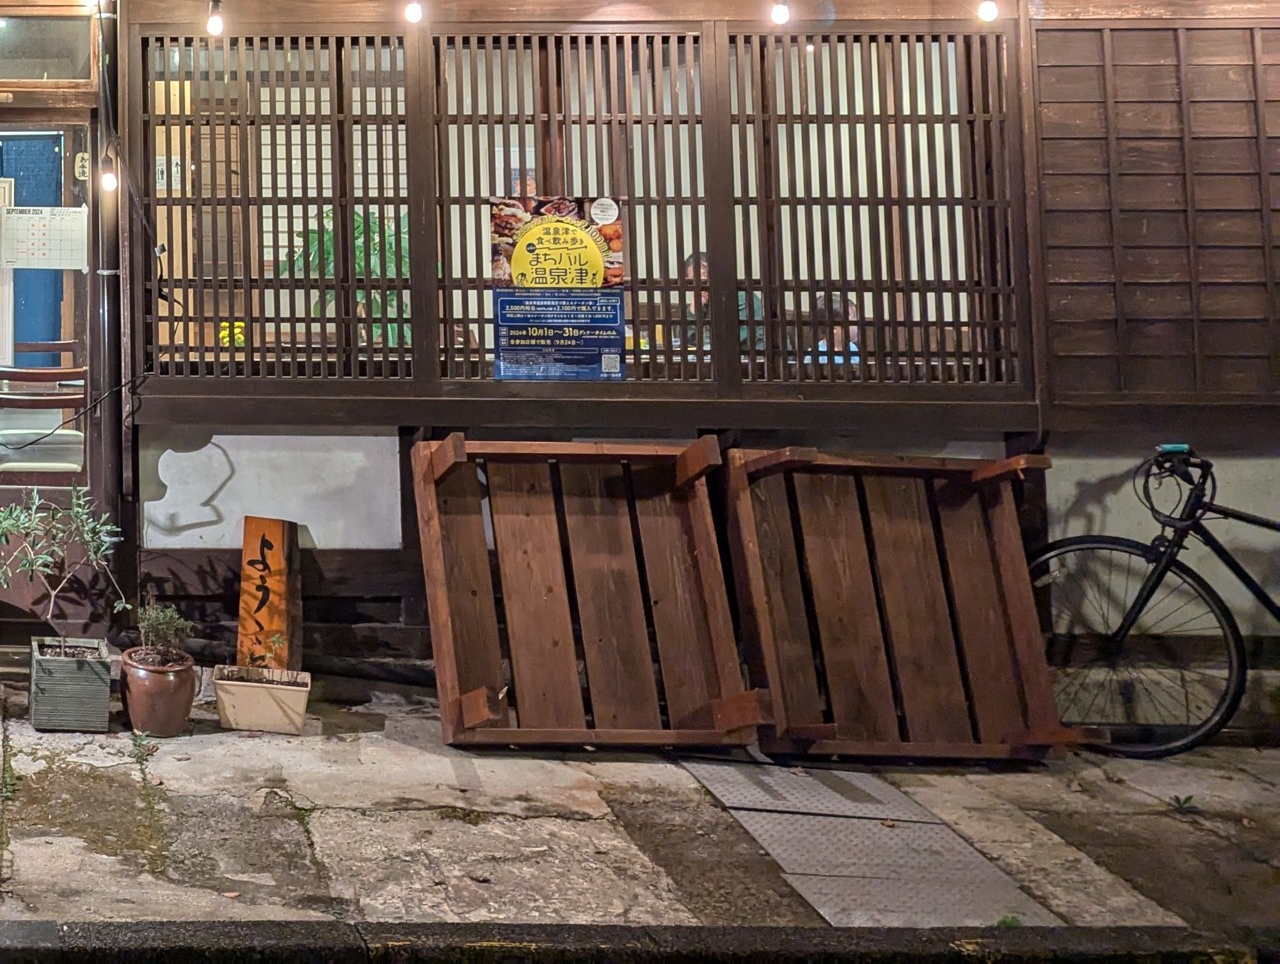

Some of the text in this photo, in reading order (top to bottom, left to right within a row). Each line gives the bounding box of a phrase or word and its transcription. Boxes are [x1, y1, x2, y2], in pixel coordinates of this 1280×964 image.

[529, 253, 589, 267] まちバル
[530, 267, 589, 285] 温泉津
